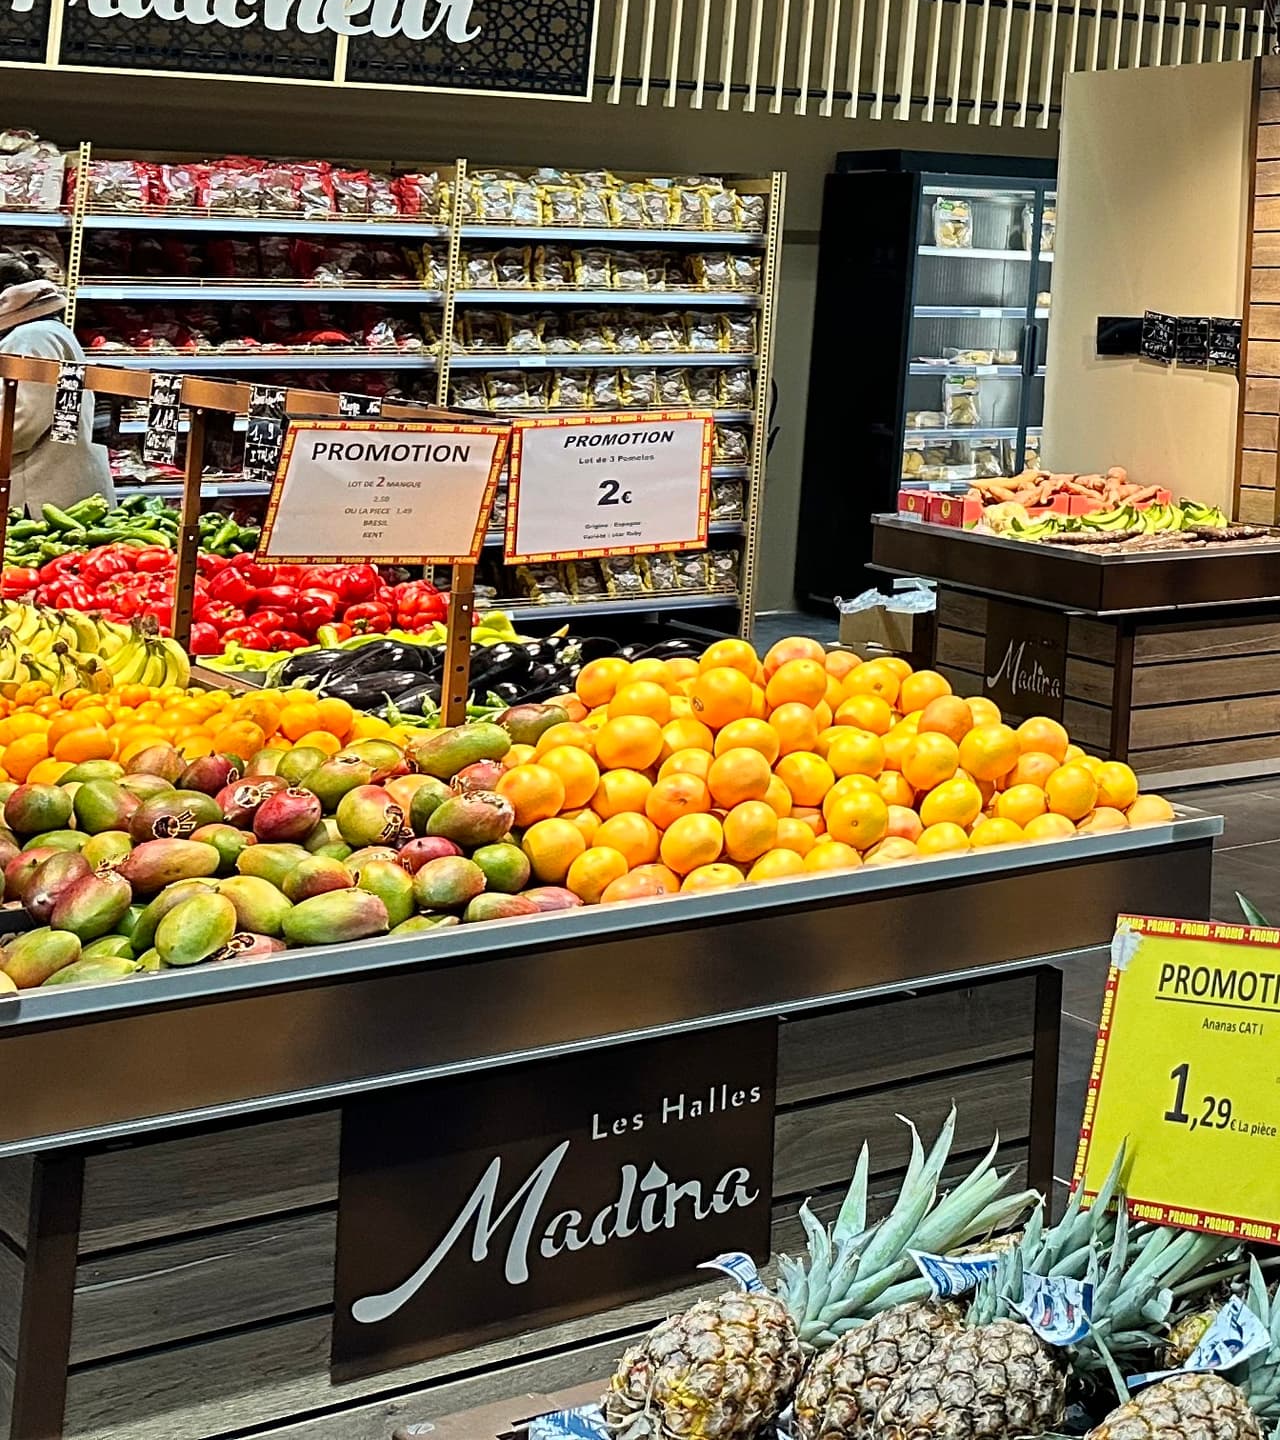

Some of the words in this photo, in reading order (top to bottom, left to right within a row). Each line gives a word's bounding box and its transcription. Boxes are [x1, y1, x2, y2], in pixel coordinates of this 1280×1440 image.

[563, 430, 676, 449] PROMOTION
[311, 442, 471, 463] PROMOTION
[578, 456, 593, 465] Lot
[595, 456, 607, 464] de
[609, 455, 615, 464] 3
[347, 479, 362, 488] LOT
[363, 479, 375, 488] DE
[375, 476, 386, 489] 2
[386, 480, 423, 489] MANGUE
[986, 639, 1061, 699] Madina
[1146, 919, 1176, 934] PROMO
[1180, 922, 1210, 938] PROMO
[1214, 926, 1244, 941] PROMO
[1249, 929, 1280, 944] PROMO
[1202, 1017, 1237, 1034] Ananas
[1238, 1021, 1258, 1035] CAT
[1073, 1137, 1088, 1181] PROMO
[1082, 1087, 1097, 1130] PROMO
[1091, 1038, 1106, 1080] PROMO
[1099, 989, 1114, 1031] PROMO
[591, 1110, 644, 1141] Les
[662, 1082, 762, 1125] Halles
[1238, 1120, 1248, 1133] La
[1250, 1122, 1277, 1137] pièce
[351, 1140, 760, 1323] Madina
[1133, 1203, 1163, 1220] PROMO
[1167, 1210, 1198, 1226] PROMO
[1203, 1216, 1236, 1233] PROMO
[1239, 1223, 1272, 1240] PROMO
